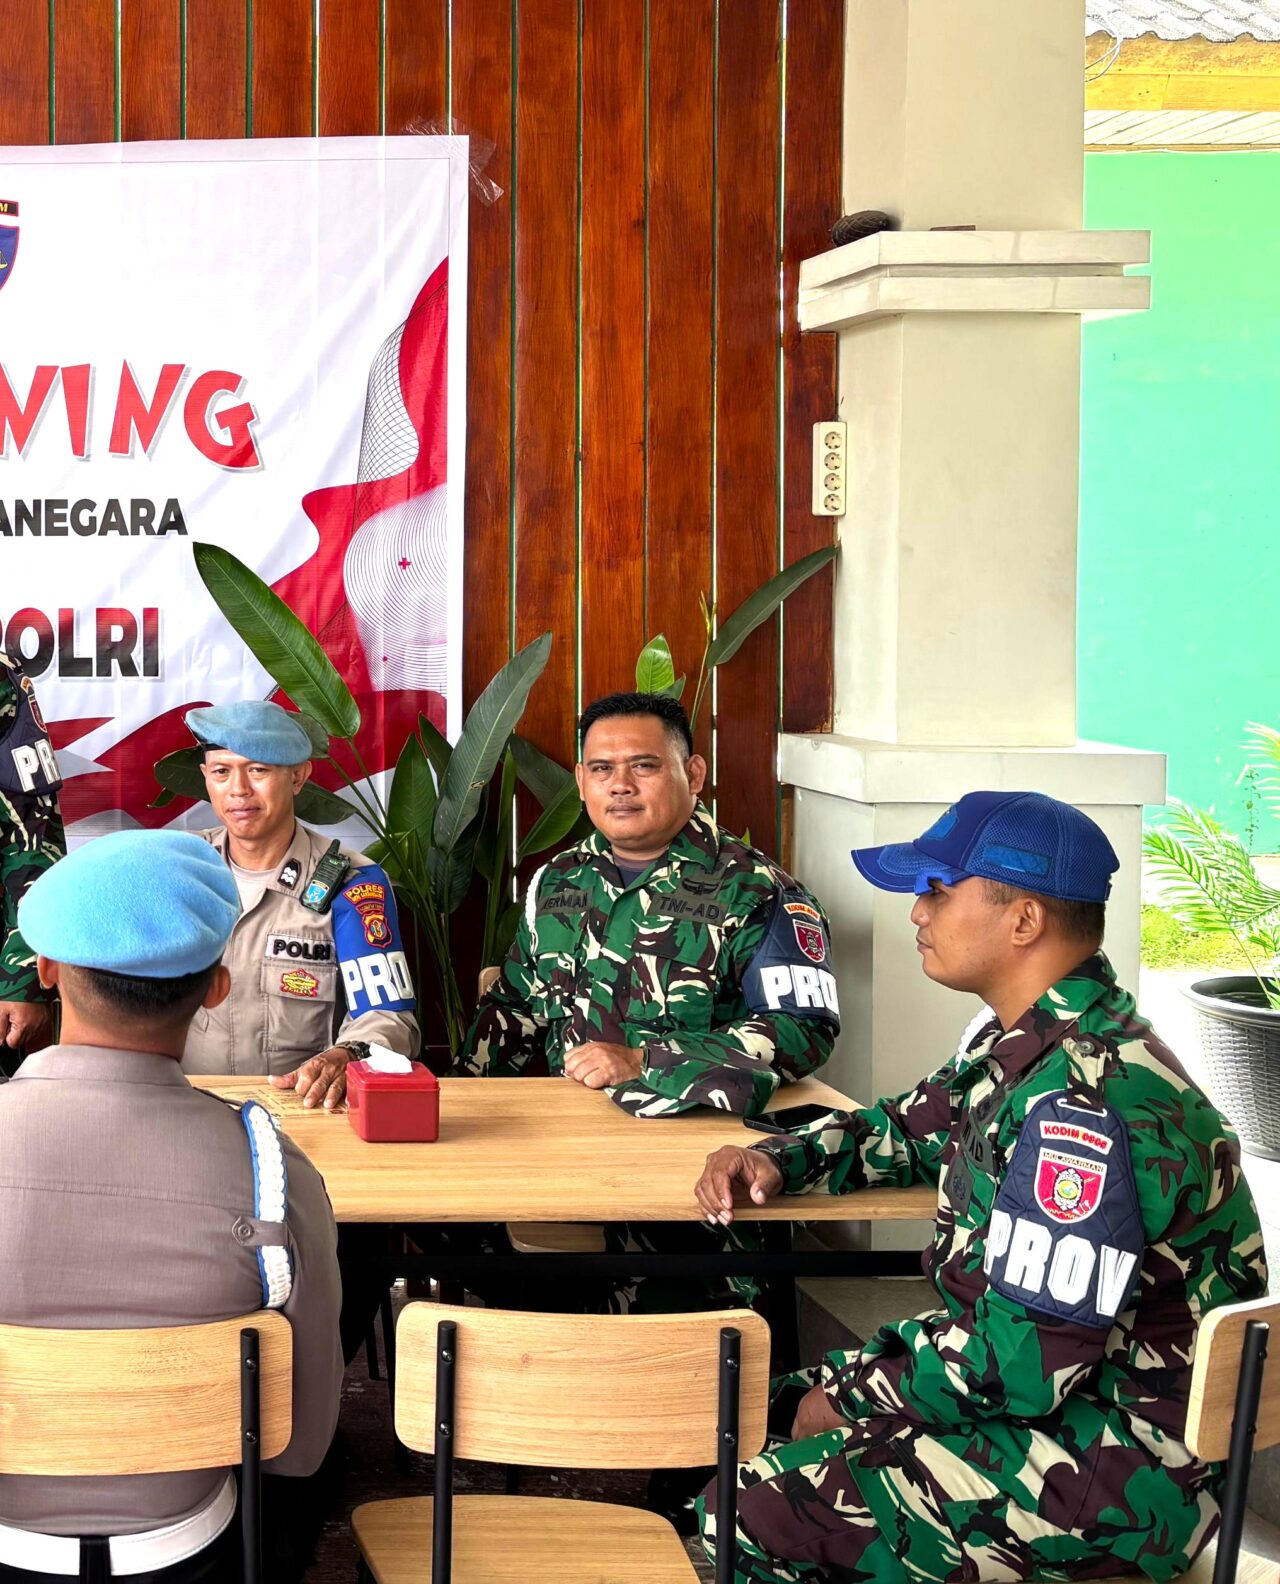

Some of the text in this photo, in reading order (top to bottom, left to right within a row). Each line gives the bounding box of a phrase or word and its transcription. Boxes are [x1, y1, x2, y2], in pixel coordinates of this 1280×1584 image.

[10, 739, 60, 792] PR
[346, 884, 383, 899] POLRES
[660, 897, 719, 918] TNI-AD
[273, 938, 332, 960] POLRI
[339, 951, 414, 1011] PRO
[759, 964, 840, 1020] PRO
[1044, 1125, 1080, 1139] KODIM
[983, 1209, 1137, 1318] PROV
